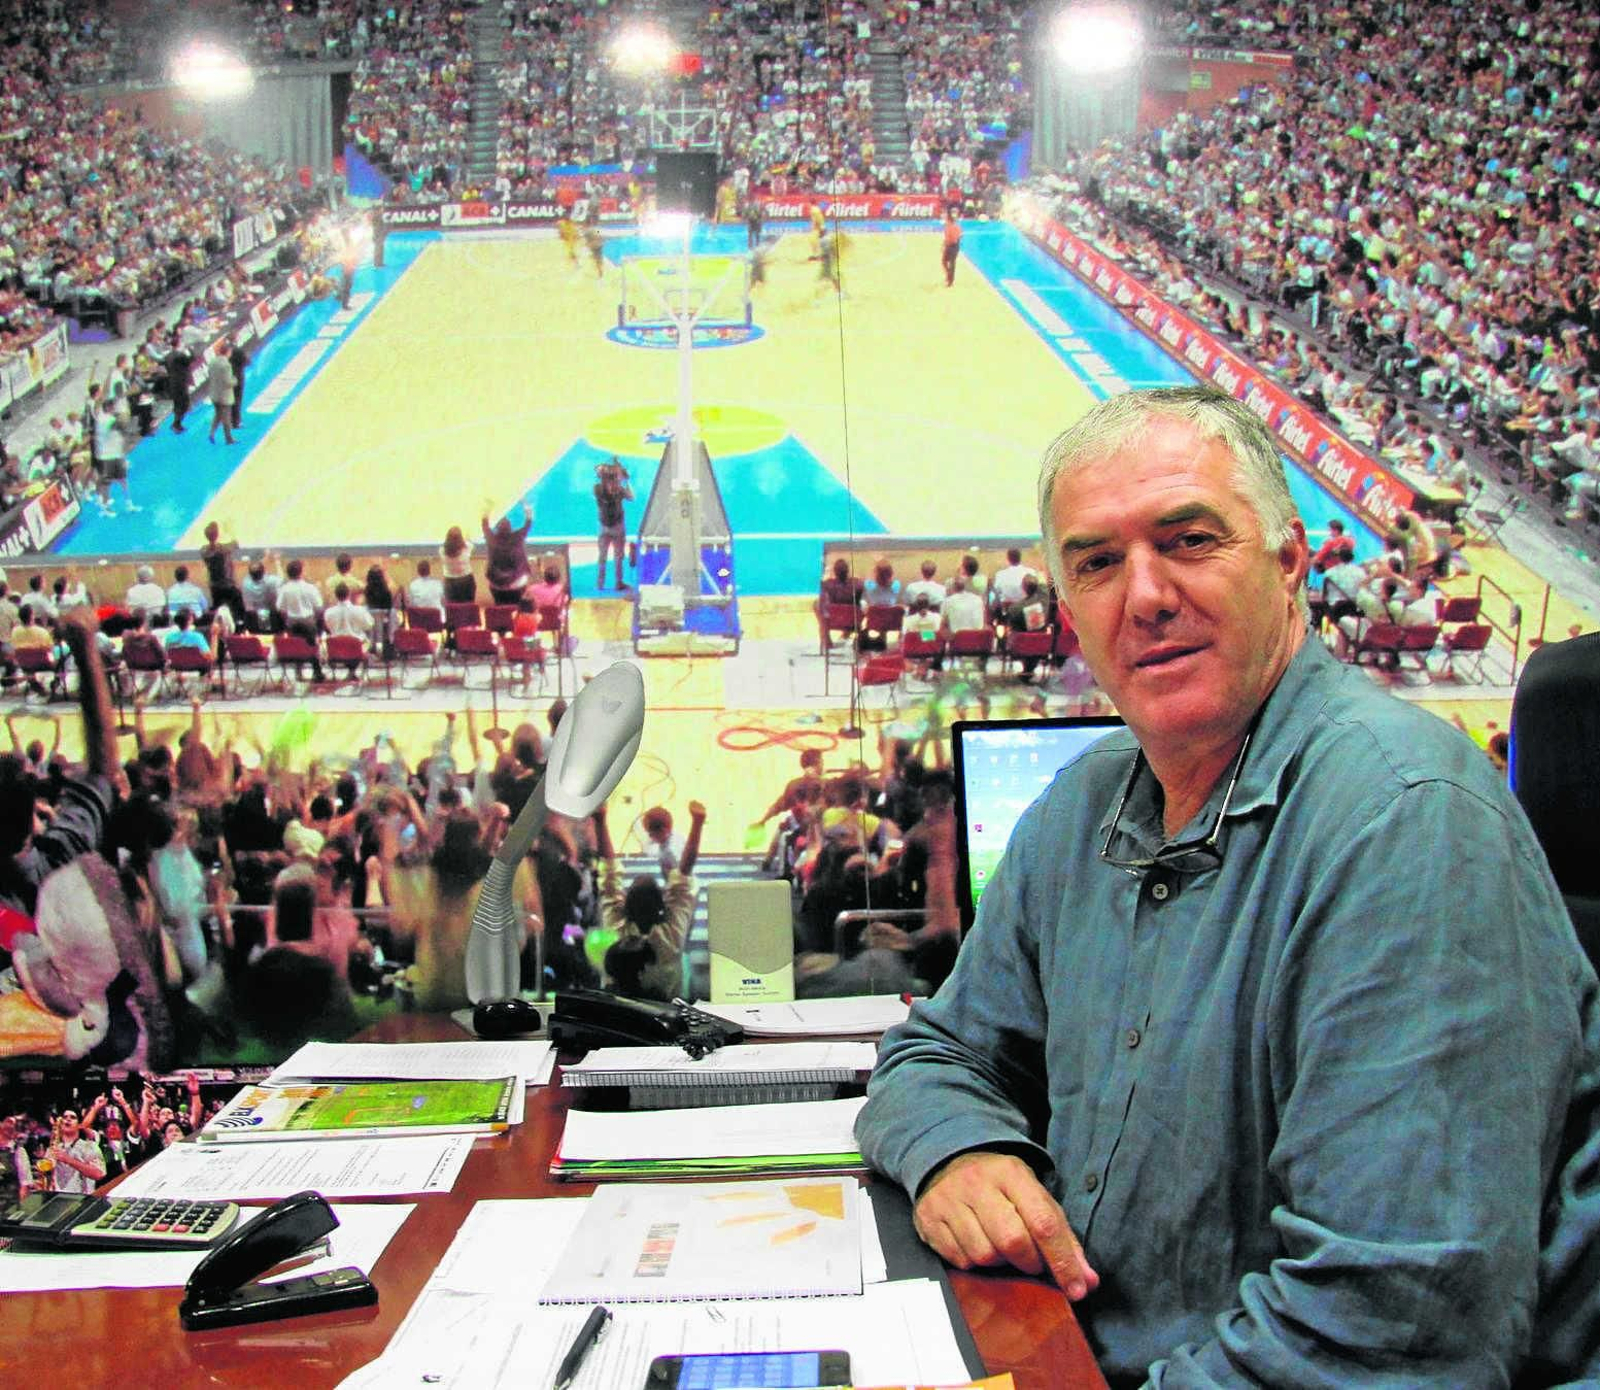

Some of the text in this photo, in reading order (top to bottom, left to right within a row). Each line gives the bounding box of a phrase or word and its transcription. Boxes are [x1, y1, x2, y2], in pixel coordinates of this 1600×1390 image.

[507, 205, 567, 218] CANAL+
[825, 202, 869, 216] Airtel
[891, 202, 934, 216] Airtel
[382, 210, 440, 223] CANAL+
